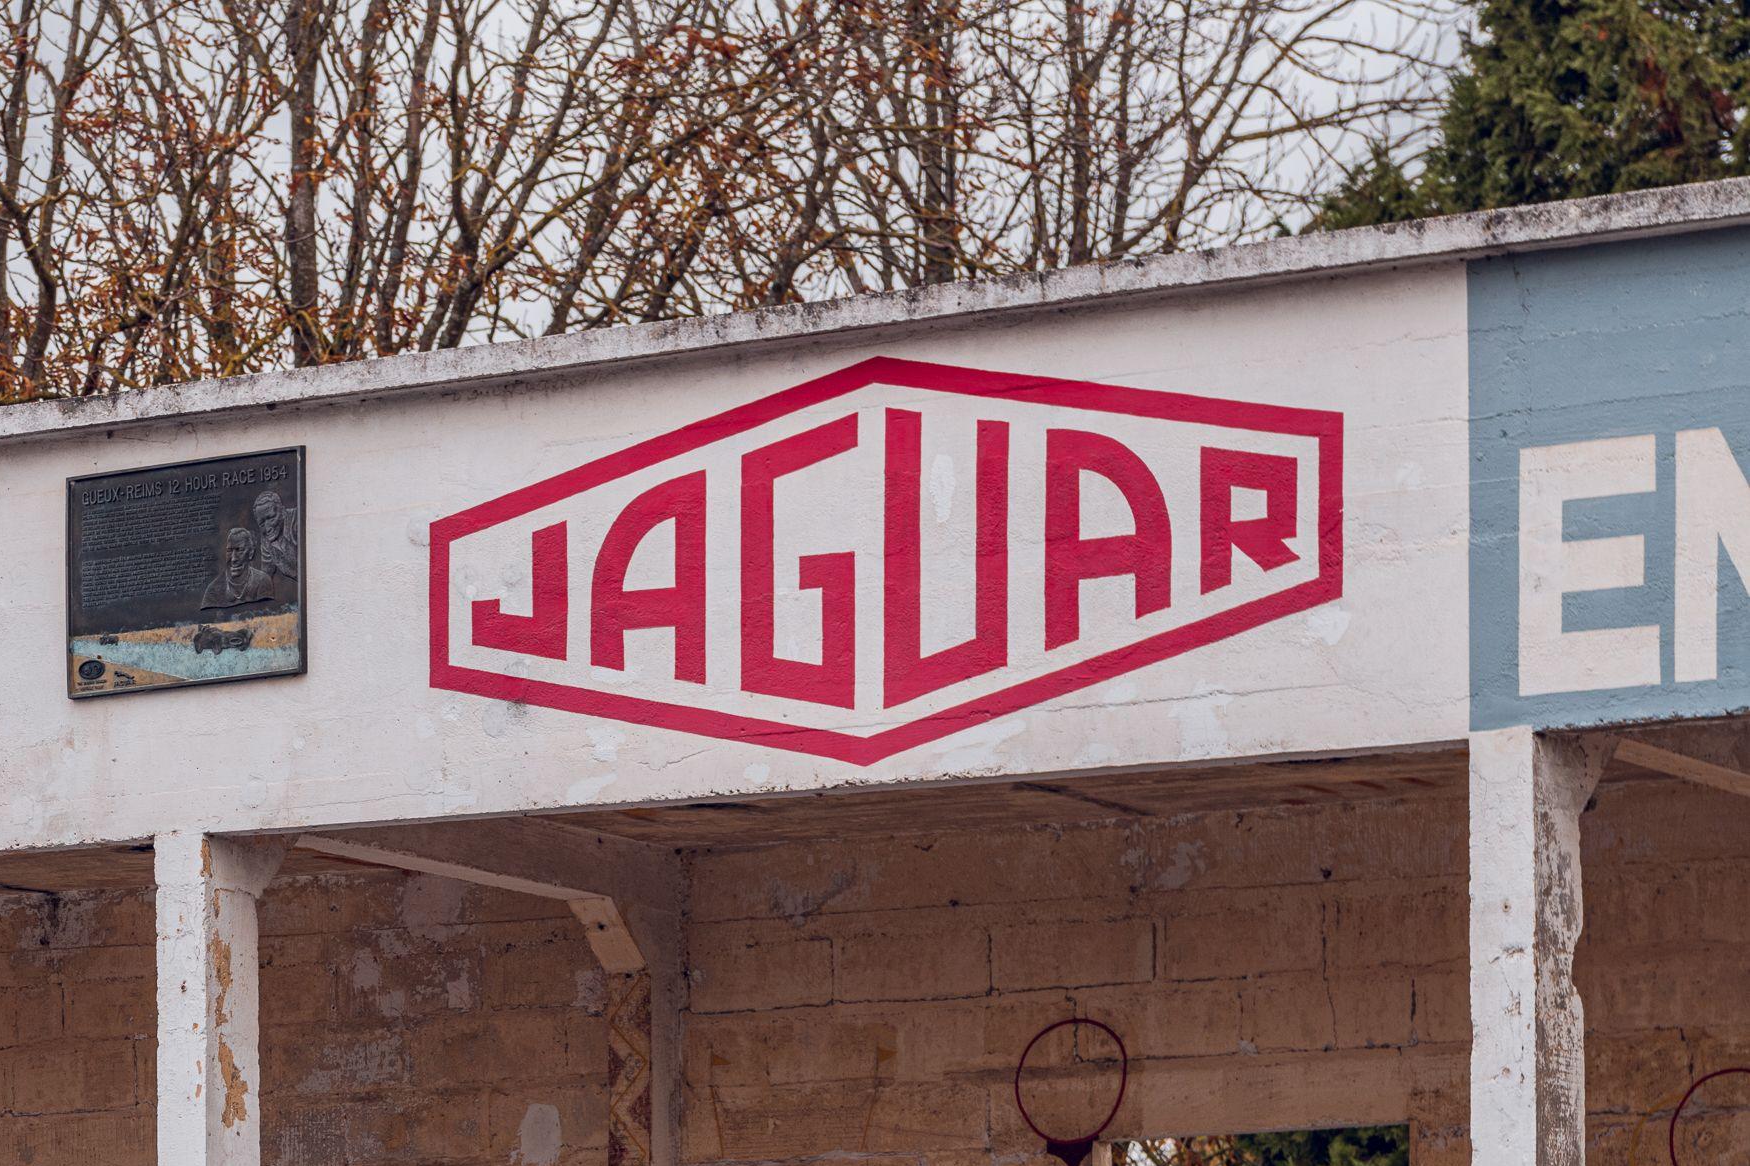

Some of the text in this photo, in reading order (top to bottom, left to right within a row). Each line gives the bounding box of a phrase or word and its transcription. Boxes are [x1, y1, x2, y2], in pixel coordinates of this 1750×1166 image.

[82, 465, 288, 506] GUEUX-REIMS 12 HOUR RACE 1954
[471, 407, 1299, 710] JAGUAR
